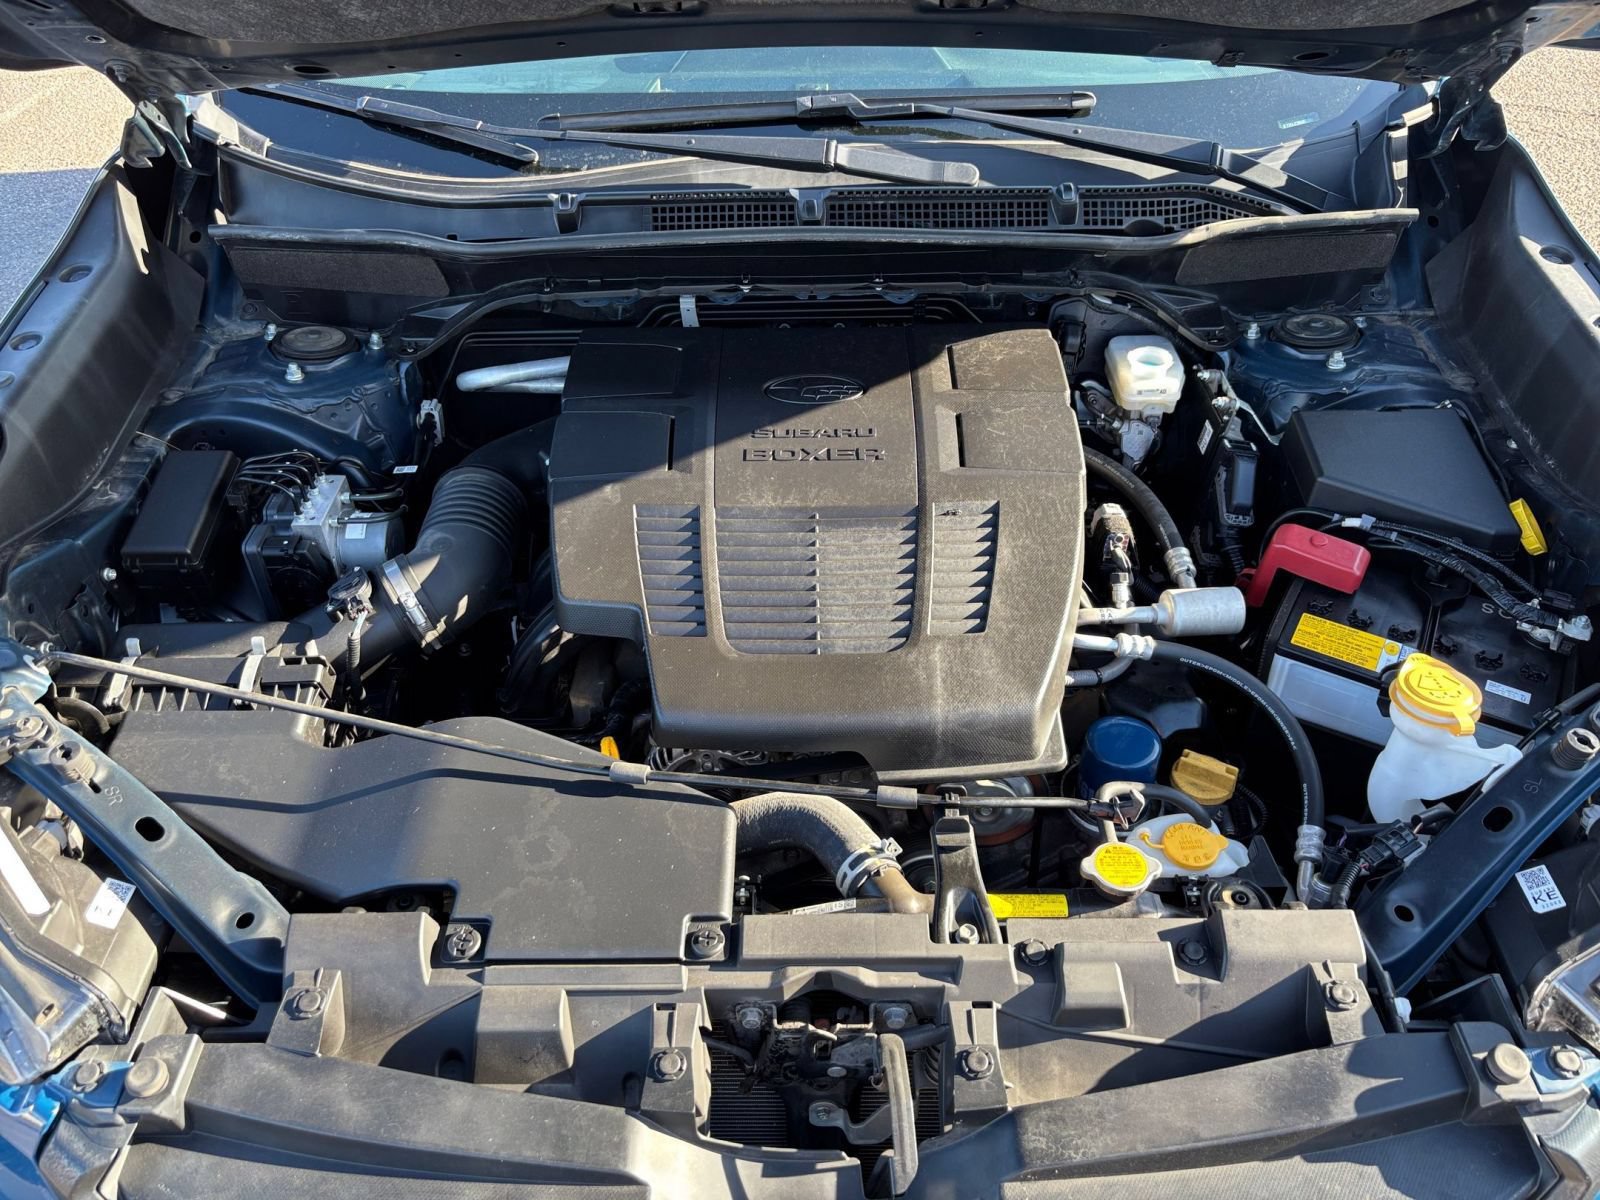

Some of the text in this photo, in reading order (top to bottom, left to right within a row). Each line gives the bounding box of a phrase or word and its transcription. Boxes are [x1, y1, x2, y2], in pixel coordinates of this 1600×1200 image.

[750, 427, 877, 439] SUBARU
[742, 447, 886, 462] BOXER
[1523, 777, 1543, 794] SL
[104, 785, 124, 807] SR
[1532, 890, 1559, 905] KE
